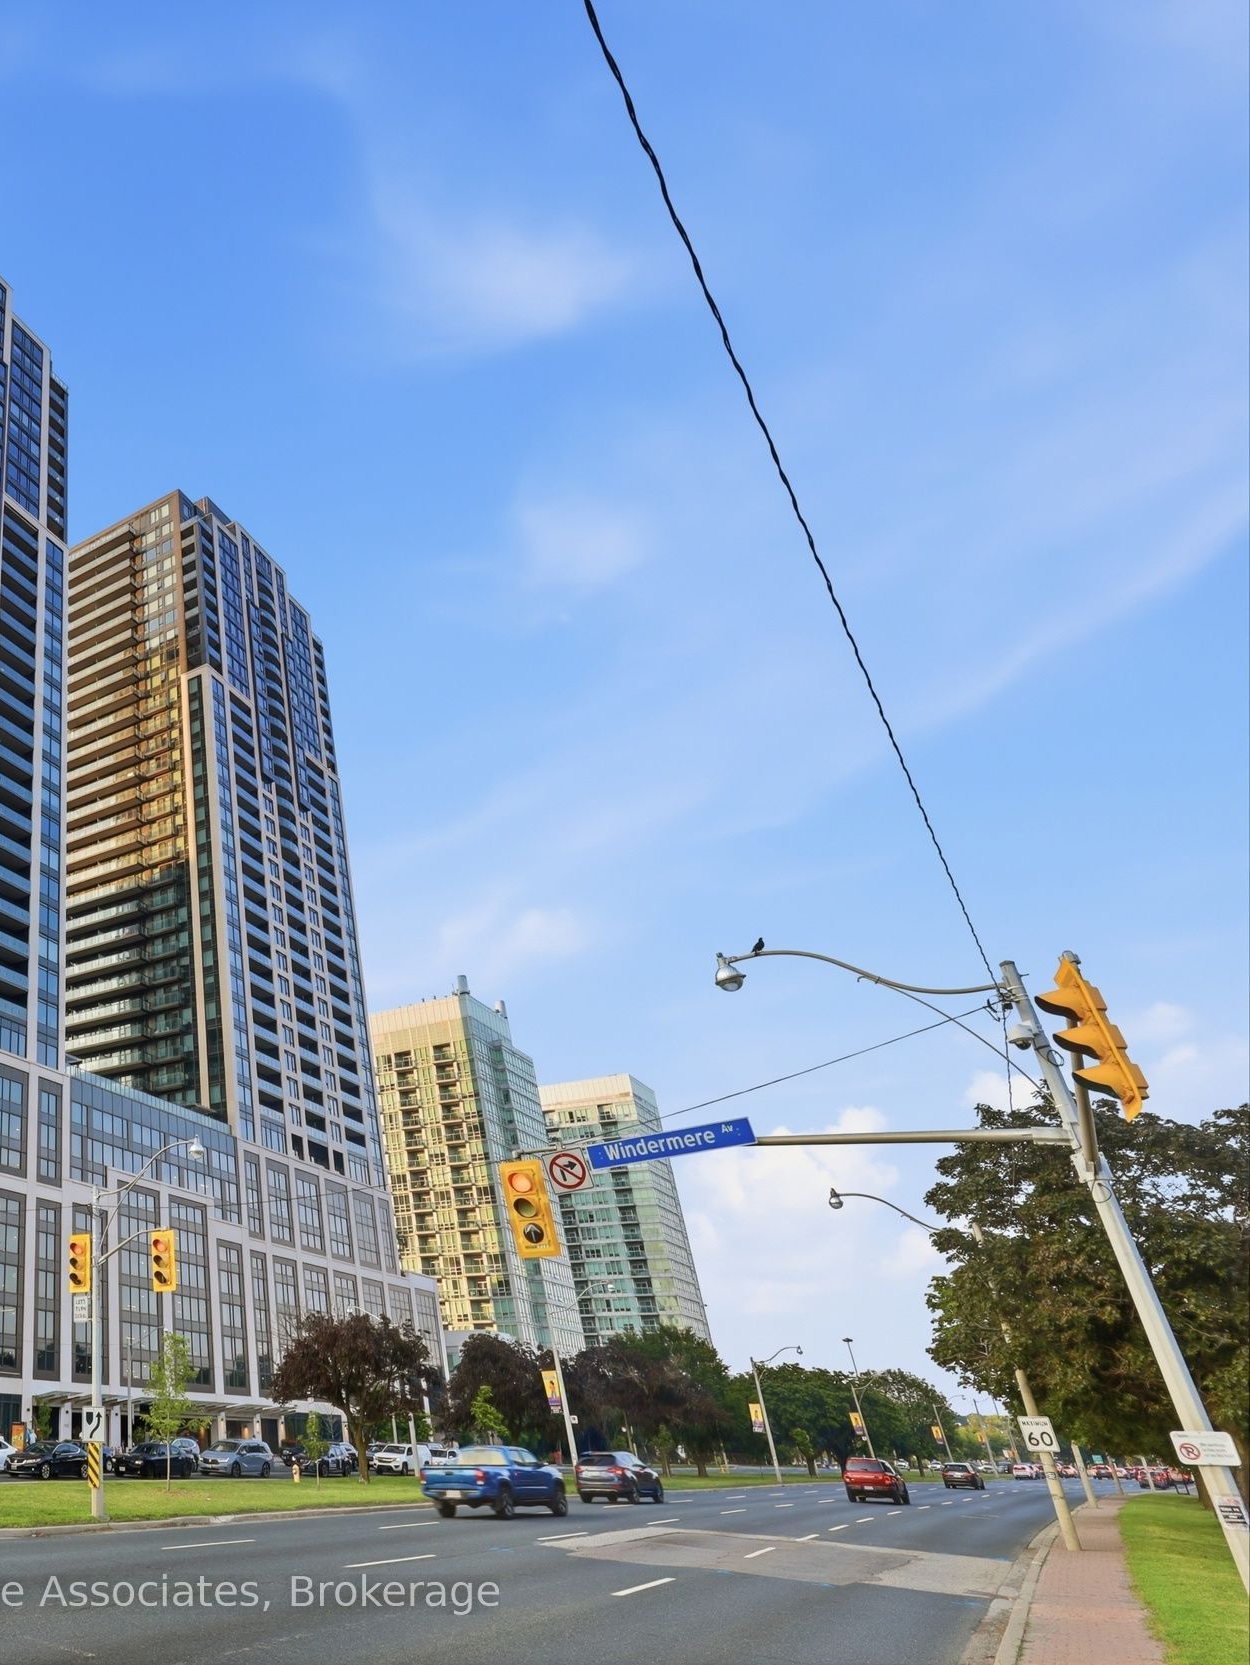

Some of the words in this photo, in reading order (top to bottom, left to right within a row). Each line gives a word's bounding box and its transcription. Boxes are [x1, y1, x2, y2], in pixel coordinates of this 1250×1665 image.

[604, 1130, 716, 1161] Windermere
[721, 1124, 734, 1134] Av
[1028, 1431, 1053, 1447] 60
